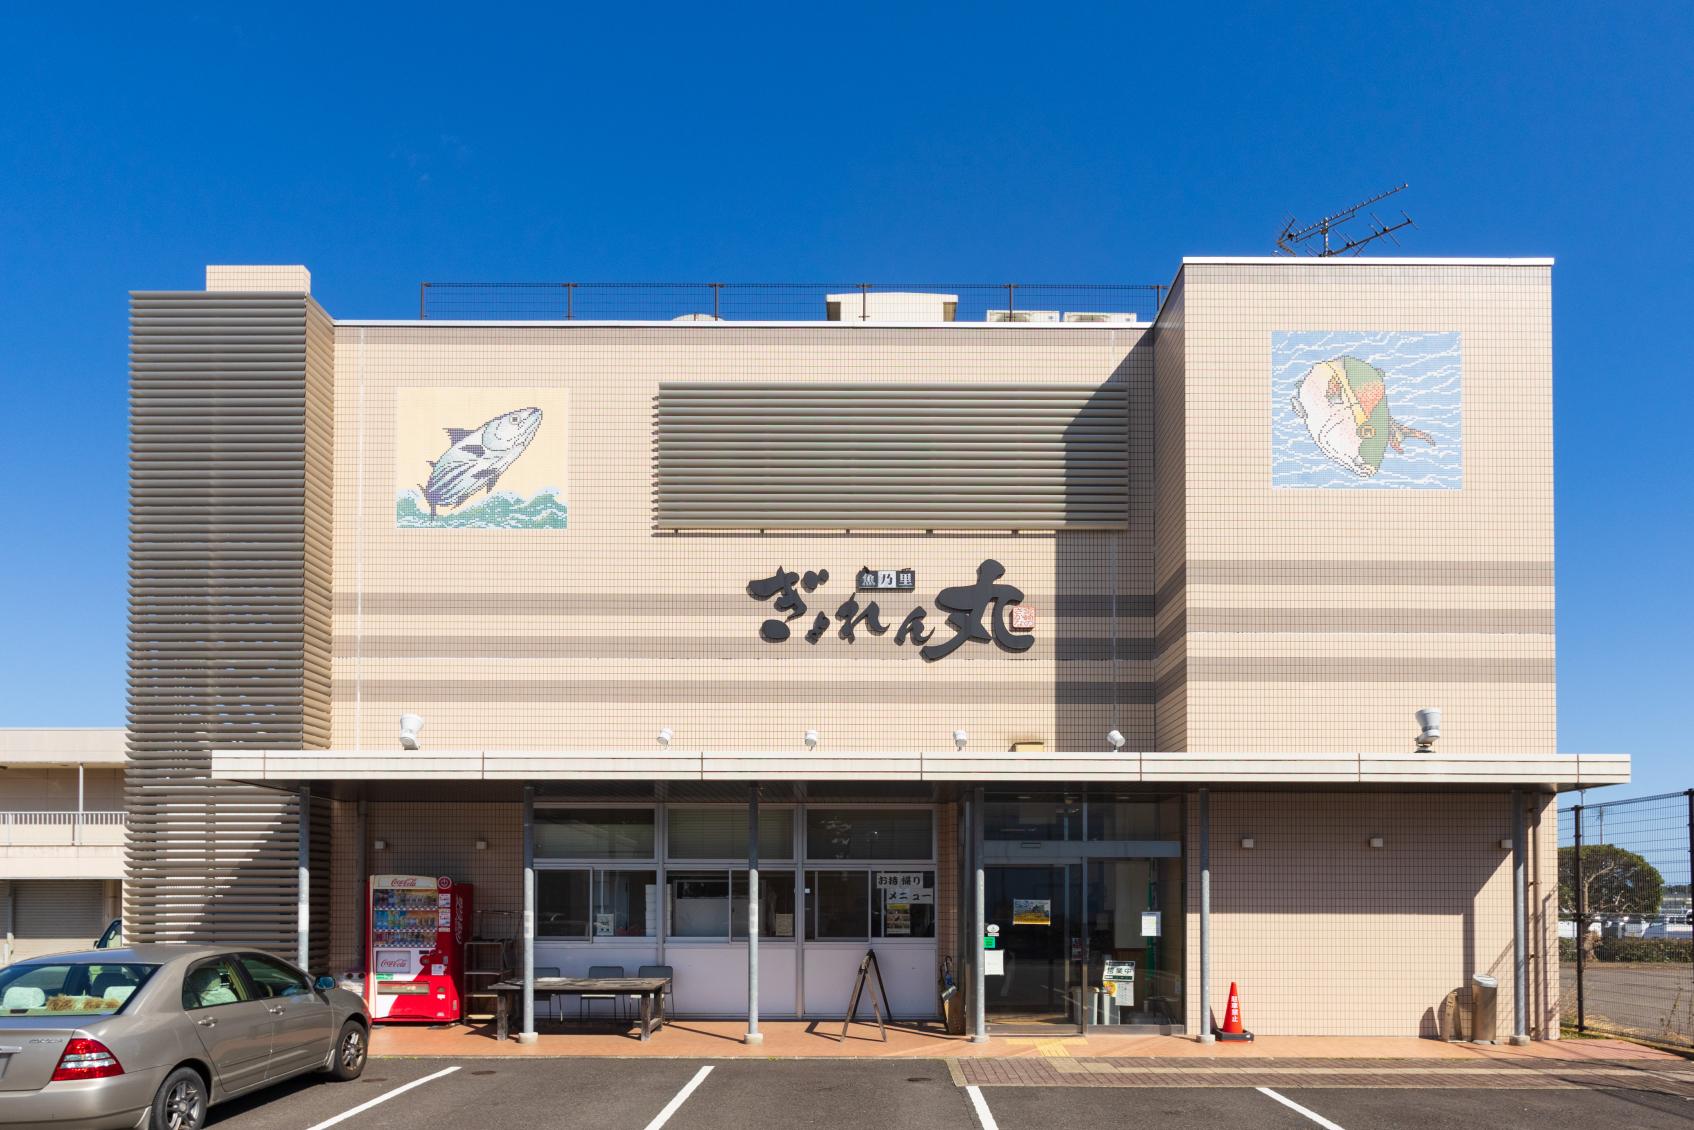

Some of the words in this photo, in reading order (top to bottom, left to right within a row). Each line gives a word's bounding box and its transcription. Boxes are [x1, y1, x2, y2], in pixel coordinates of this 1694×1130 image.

[861, 572, 913, 586] 魚乃里
[888, 891, 931, 900] メニュー
